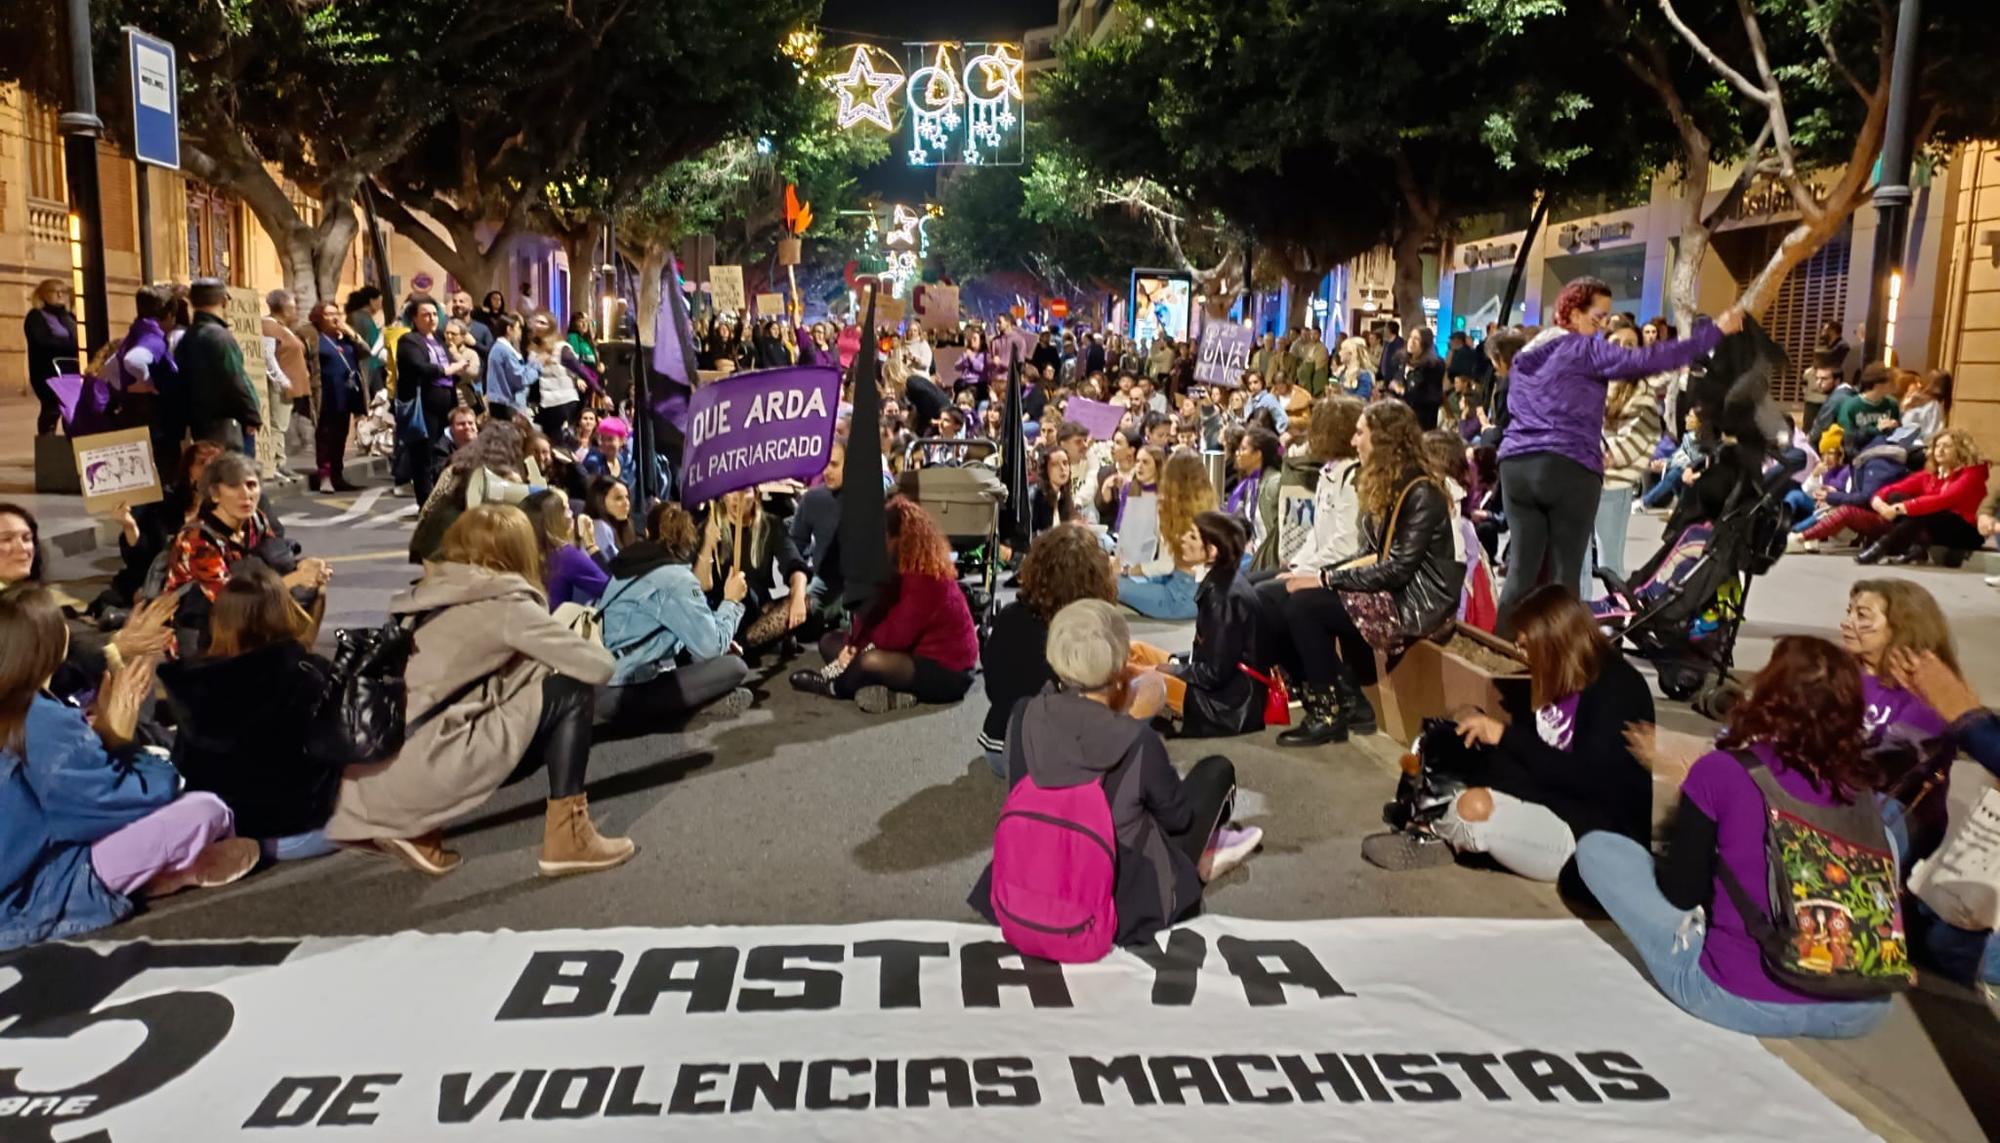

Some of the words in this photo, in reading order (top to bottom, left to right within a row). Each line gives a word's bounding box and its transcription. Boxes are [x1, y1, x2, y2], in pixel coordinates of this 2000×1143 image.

[692, 400, 731, 447] QUE
[744, 387, 827, 429] ARDA
[688, 463, 703, 487] EL
[708, 435, 822, 478] PATRIARCADO
[495, 938, 1074, 1020] BASTA
[1130, 928, 1357, 1006] YA
[241, 1073, 403, 1129] DE
[437, 1056, 1041, 1123] VIOLENCIAS
[1069, 1049, 1670, 1105] MACHISTAS
